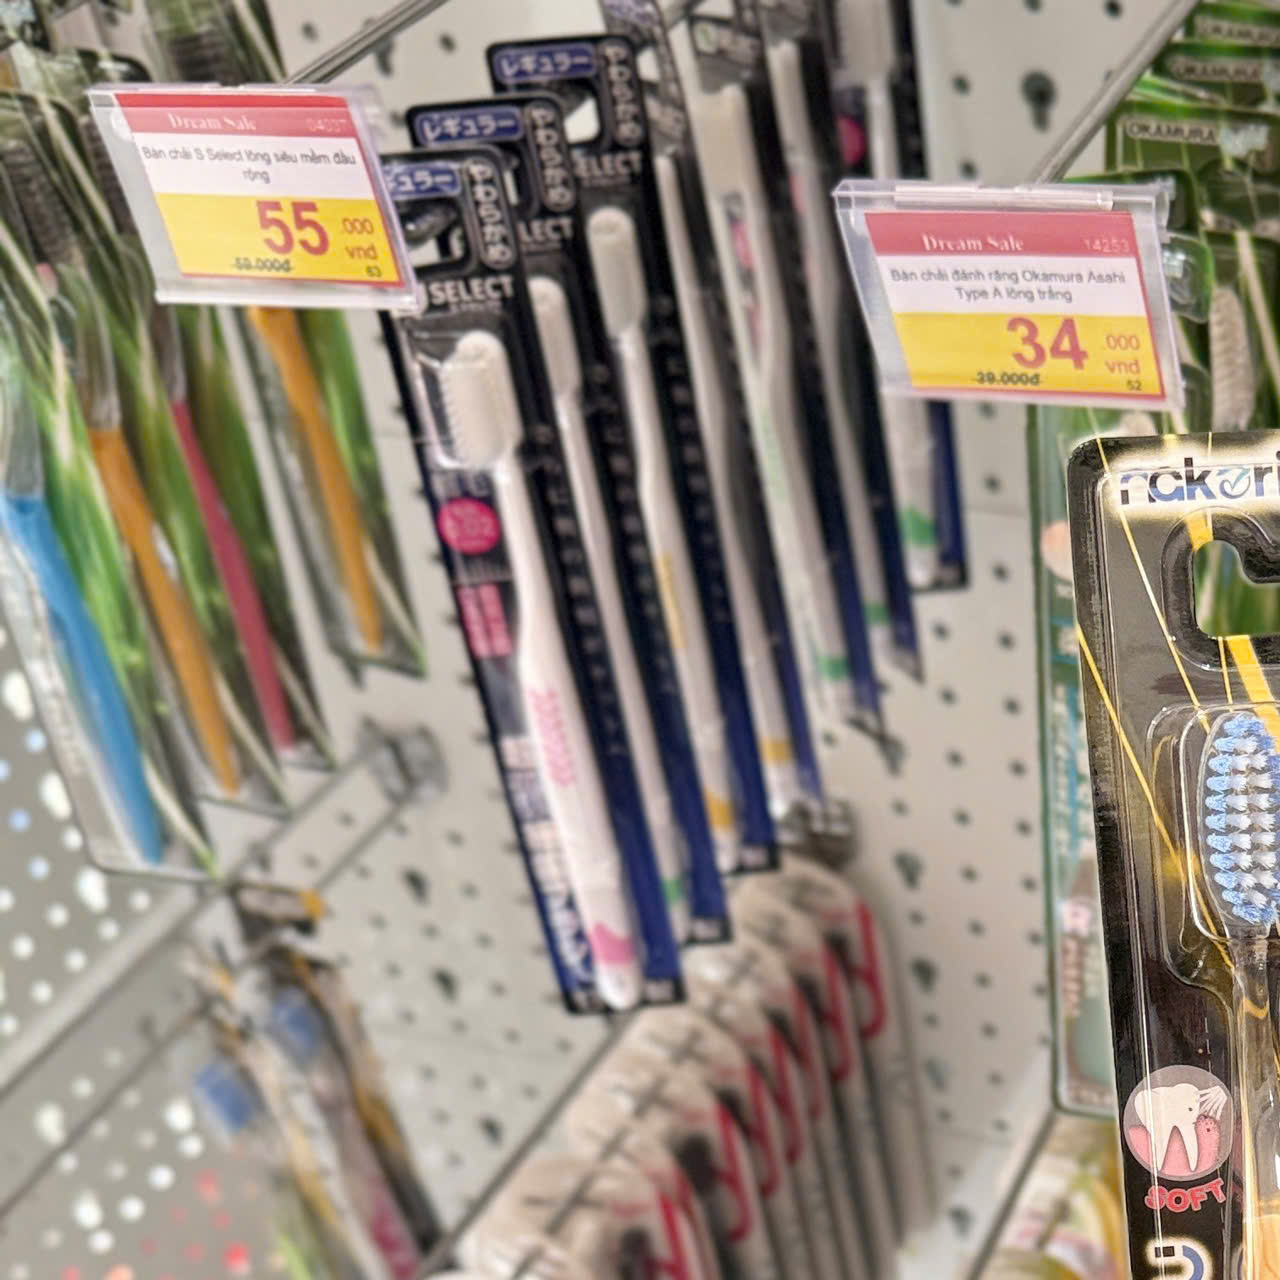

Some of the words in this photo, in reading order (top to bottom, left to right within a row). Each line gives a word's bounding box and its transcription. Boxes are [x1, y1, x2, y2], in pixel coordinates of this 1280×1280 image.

[167, 113, 222, 130] Dream
[224, 115, 257, 131] Sale
[1128, 119, 1218, 144] OKAMURA
[207, 148, 243, 163] Select
[256, 200, 329, 256] 55
[340, 218, 374, 235] .000
[921, 233, 983, 251] Dream
[986, 234, 1024, 251] Sale
[345, 244, 377, 260] vnd
[1022, 270, 1084, 283] Okamura
[1087, 271, 1126, 284] Asahi
[429, 275, 516, 305] SELECT
[955, 287, 989, 303] Type
[992, 287, 1003, 300] A
[1006, 317, 1089, 370] 34
[1105, 360, 1140, 375] vnd
[1127, 380, 1143, 391] 52
[1144, 1177, 1227, 1214] SOFT
